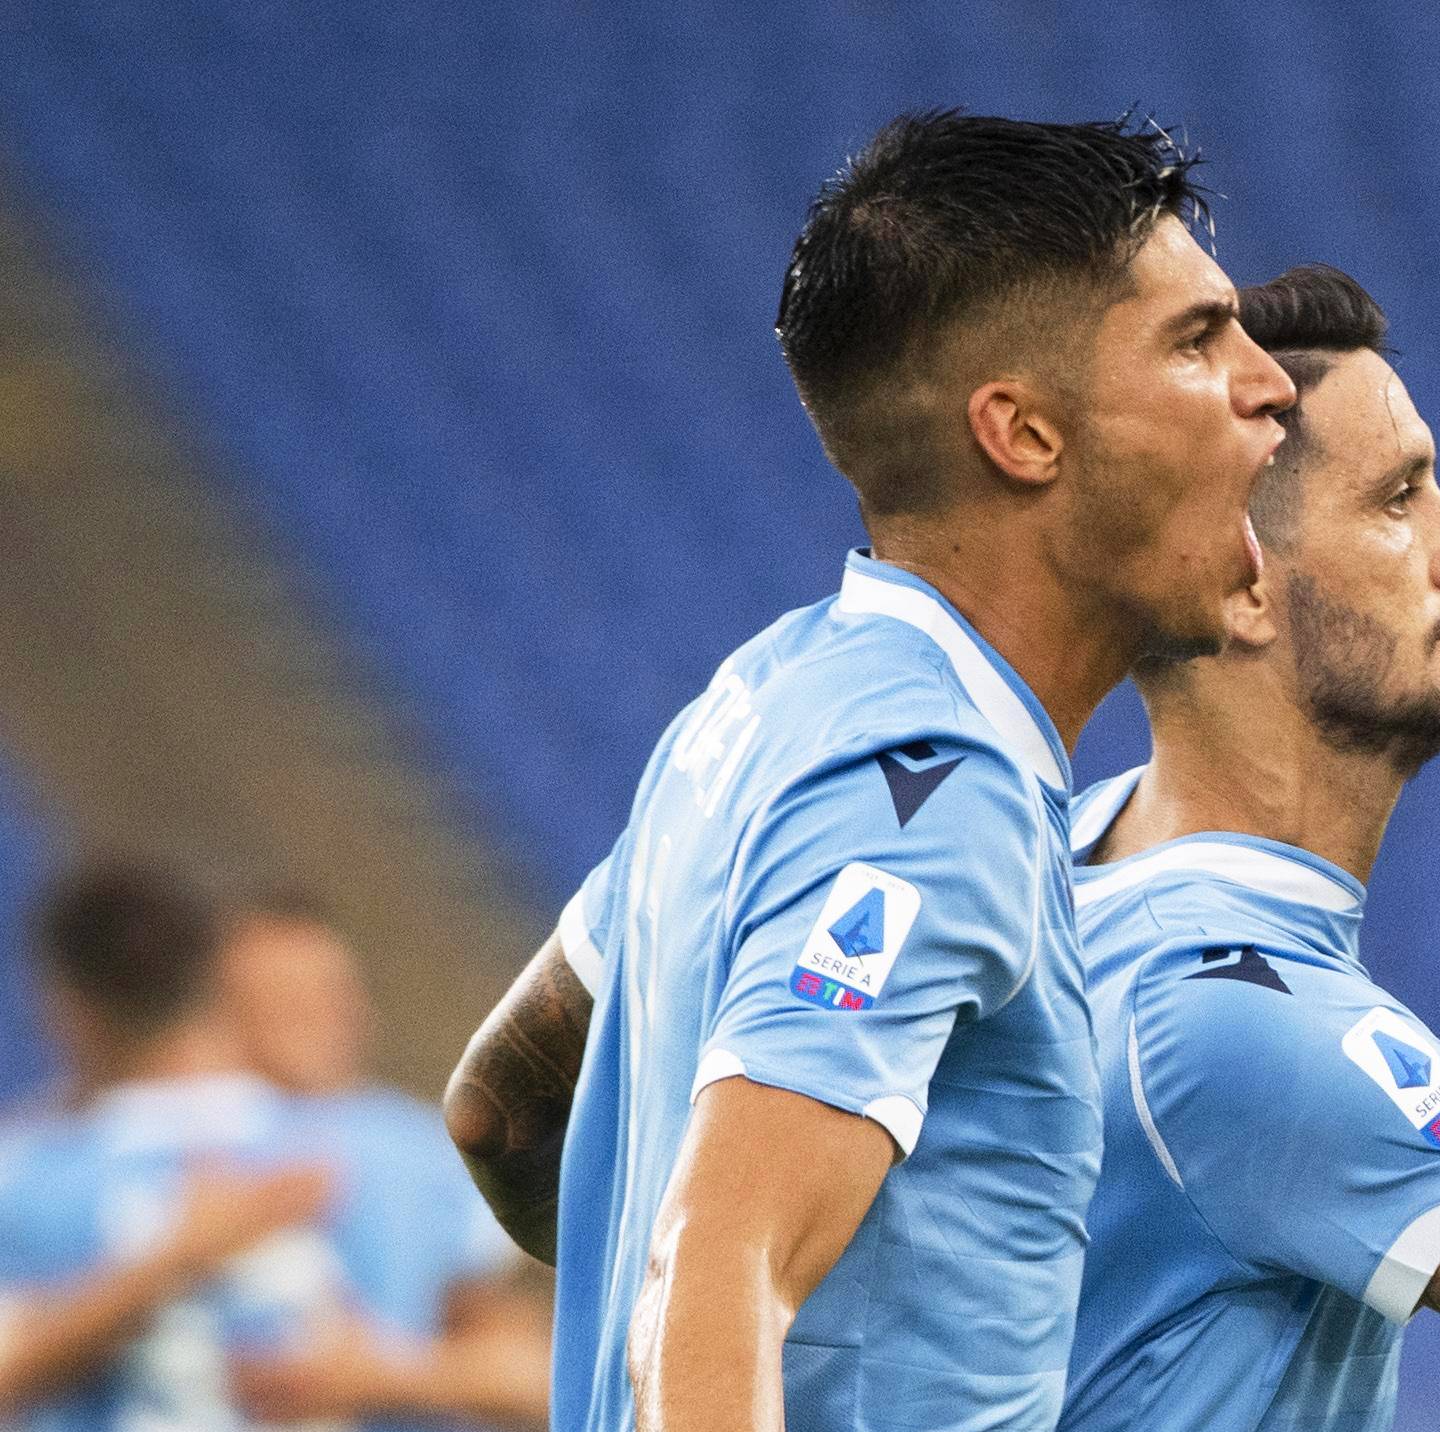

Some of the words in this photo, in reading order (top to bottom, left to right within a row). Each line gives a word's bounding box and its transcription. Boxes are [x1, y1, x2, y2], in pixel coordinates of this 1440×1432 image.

[811, 952, 857, 979] SERIE
[861, 973, 873, 987] A
[822, 982, 864, 1011] TIM
